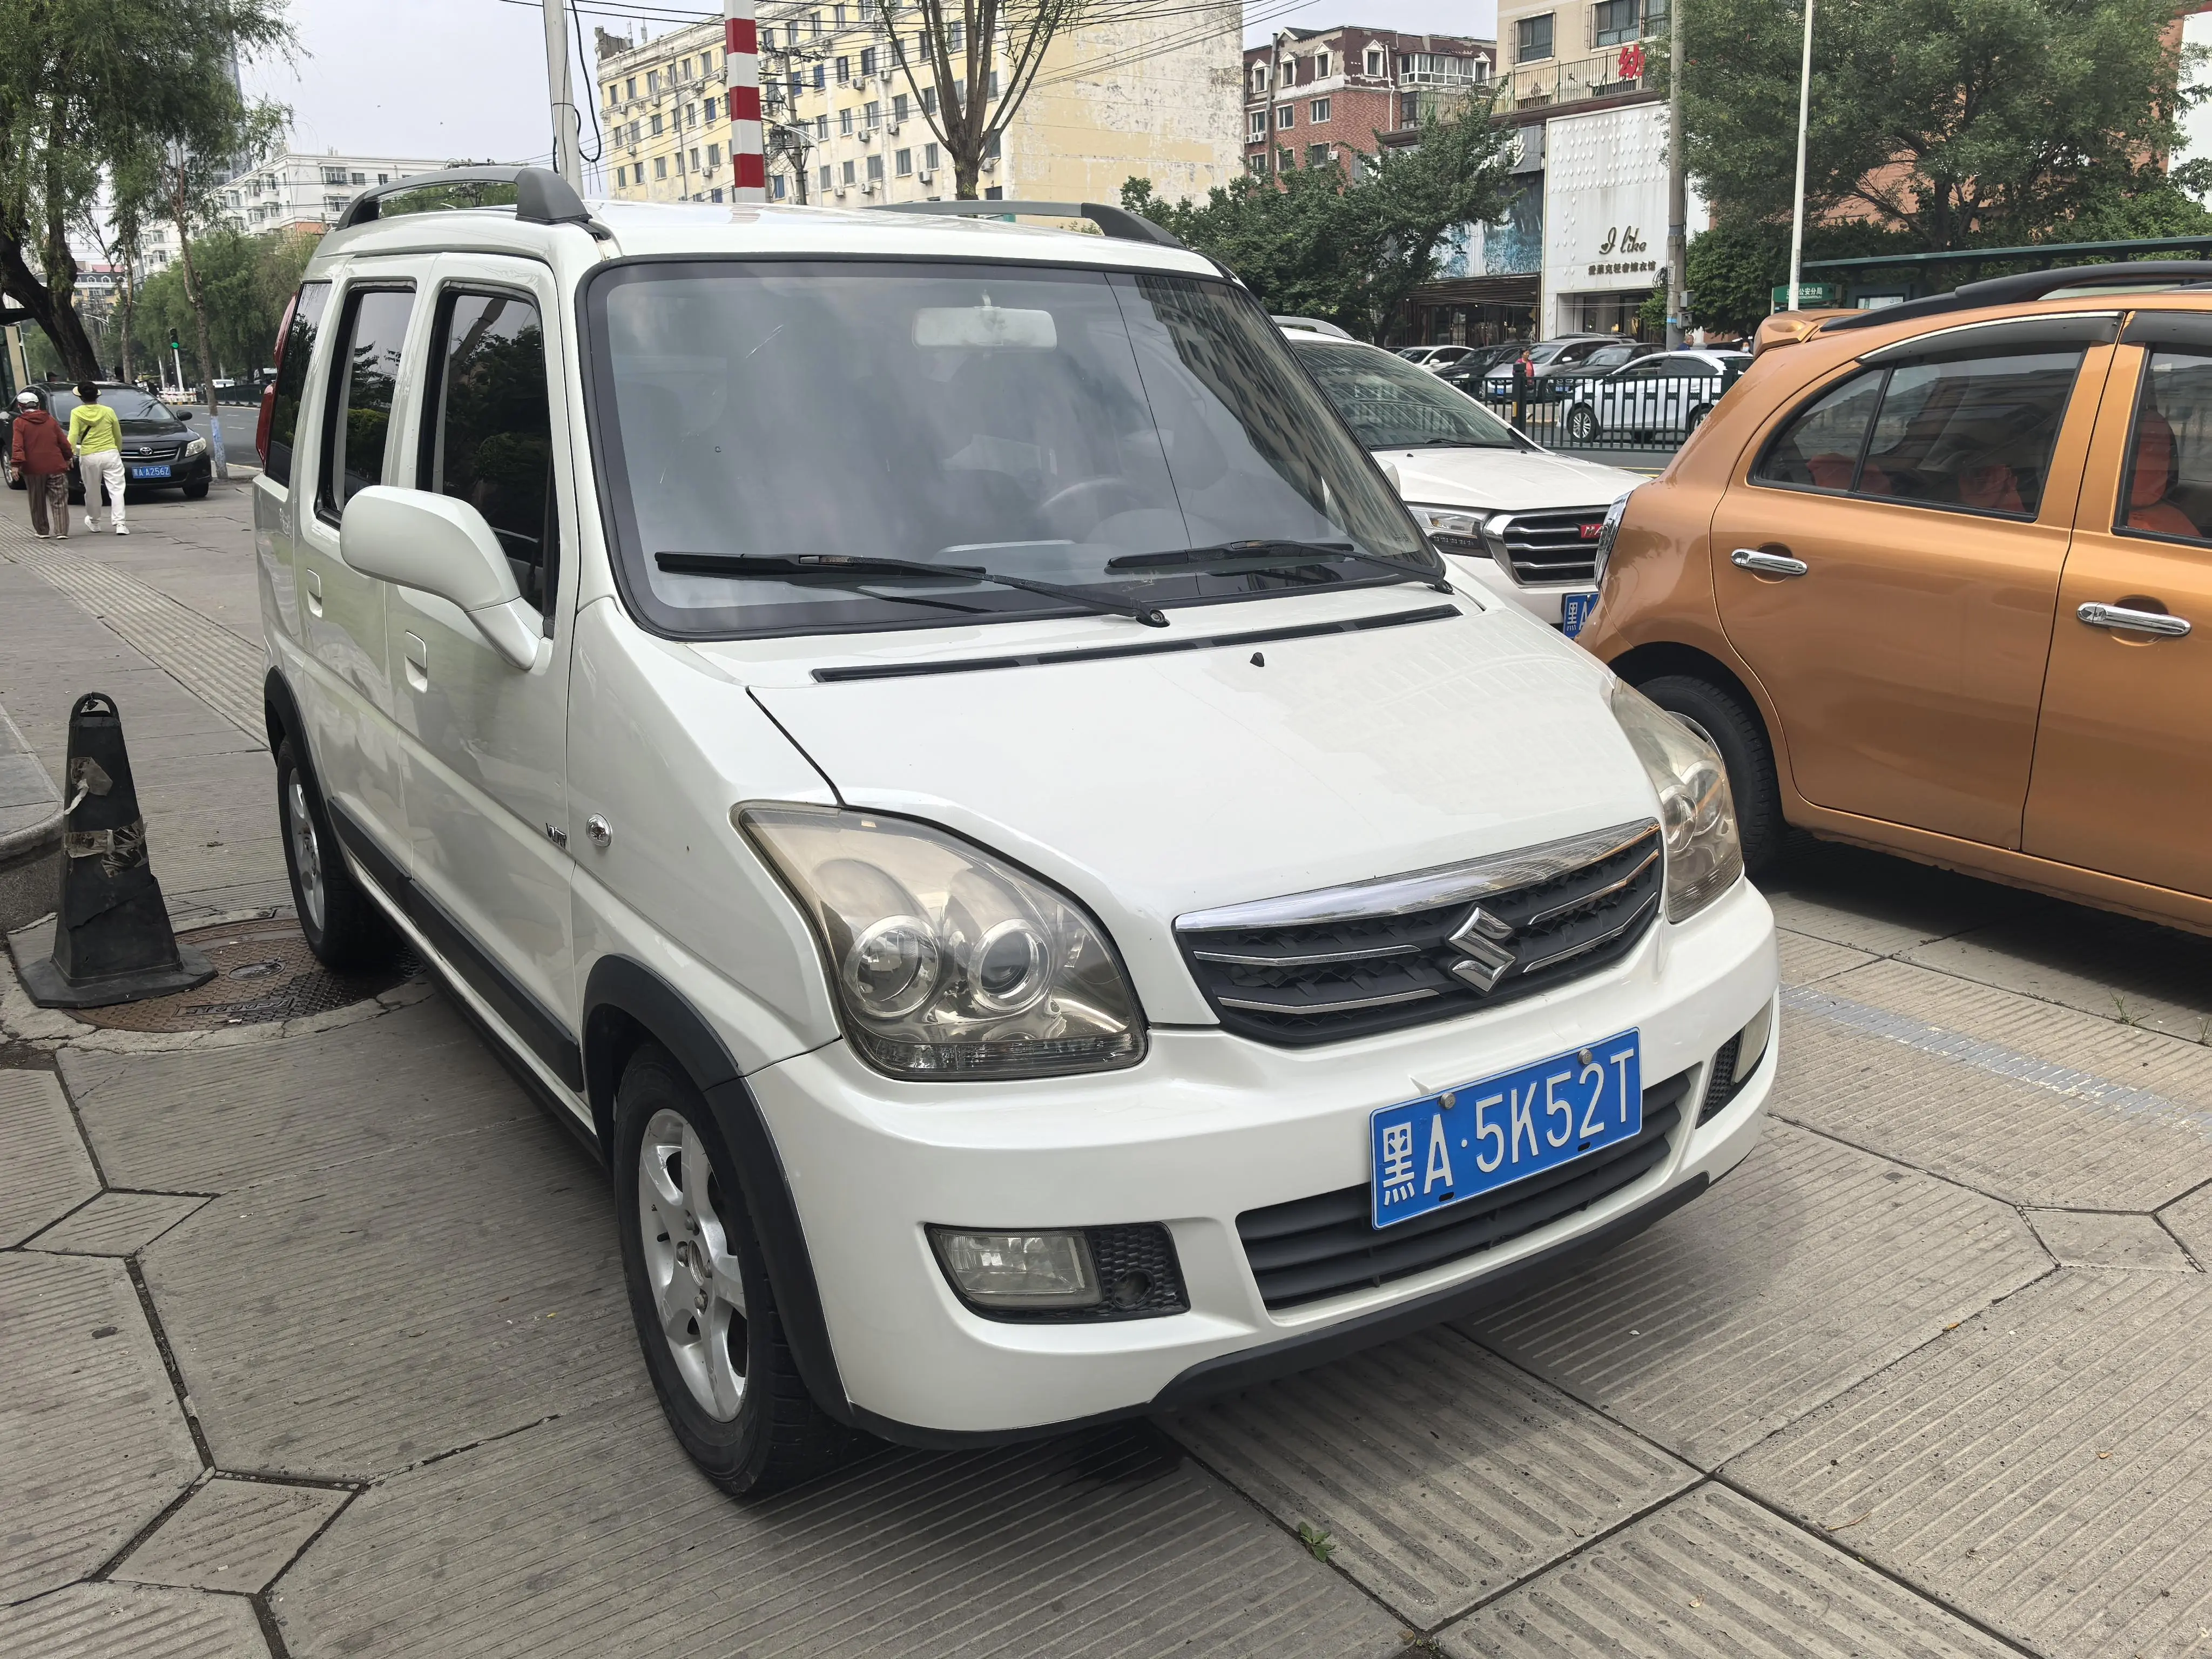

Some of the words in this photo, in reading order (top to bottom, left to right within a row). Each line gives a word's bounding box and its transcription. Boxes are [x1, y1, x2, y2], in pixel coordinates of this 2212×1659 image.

[1599, 227, 1616, 254] I
[1620, 225, 1647, 253] like
[1383, 1048, 1634, 1206] 黑A·5K52T
